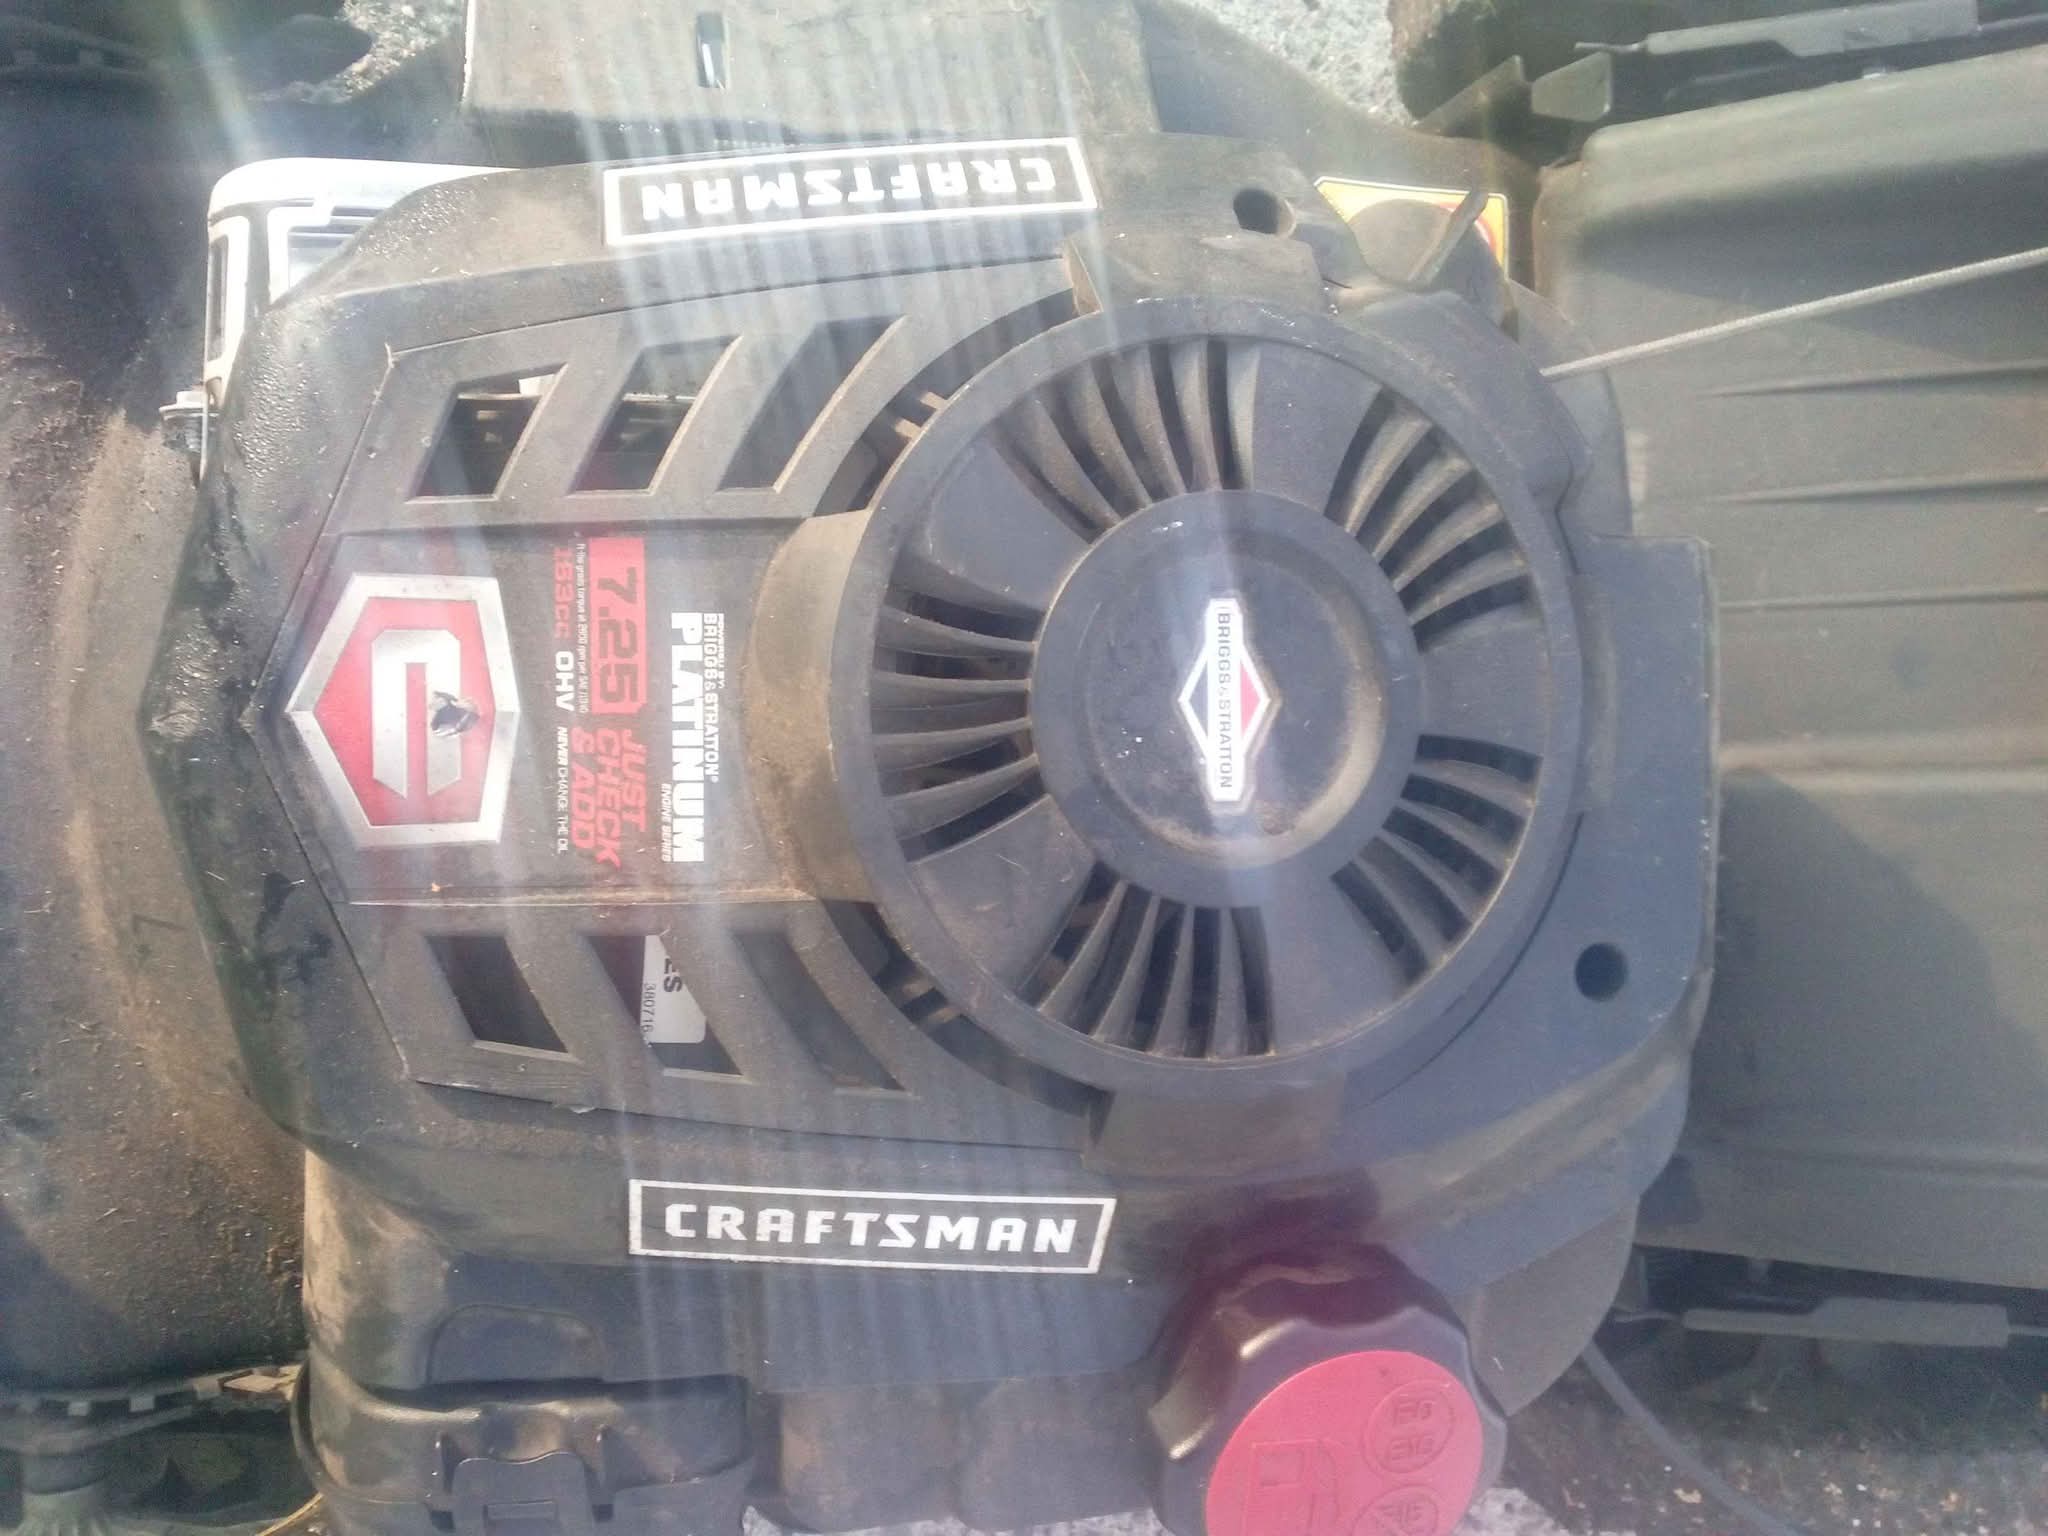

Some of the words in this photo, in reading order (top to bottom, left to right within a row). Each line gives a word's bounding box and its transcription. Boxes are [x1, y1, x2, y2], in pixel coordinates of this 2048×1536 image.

[642, 156, 1056, 220] CRAFTSMAN
[575, 588, 587, 613] torque
[575, 645, 586, 660] rpm
[599, 567, 638, 705] 7.25
[554, 651, 575, 712] OHV
[575, 662, 586, 674] per
[557, 726, 569, 766] NEVER
[571, 726, 594, 755] &
[671, 612, 705, 862] PLATINUM
[557, 767, 569, 811] CHANGE
[595, 727, 622, 868] CHECK
[621, 727, 648, 832] JUST
[571, 765, 594, 849] ADD
[661, 783, 672, 822] ENGINE
[557, 815, 569, 835] THE
[661, 825, 672, 862] SERIES
[665, 1203, 1077, 1253] CRAFTSMAN
